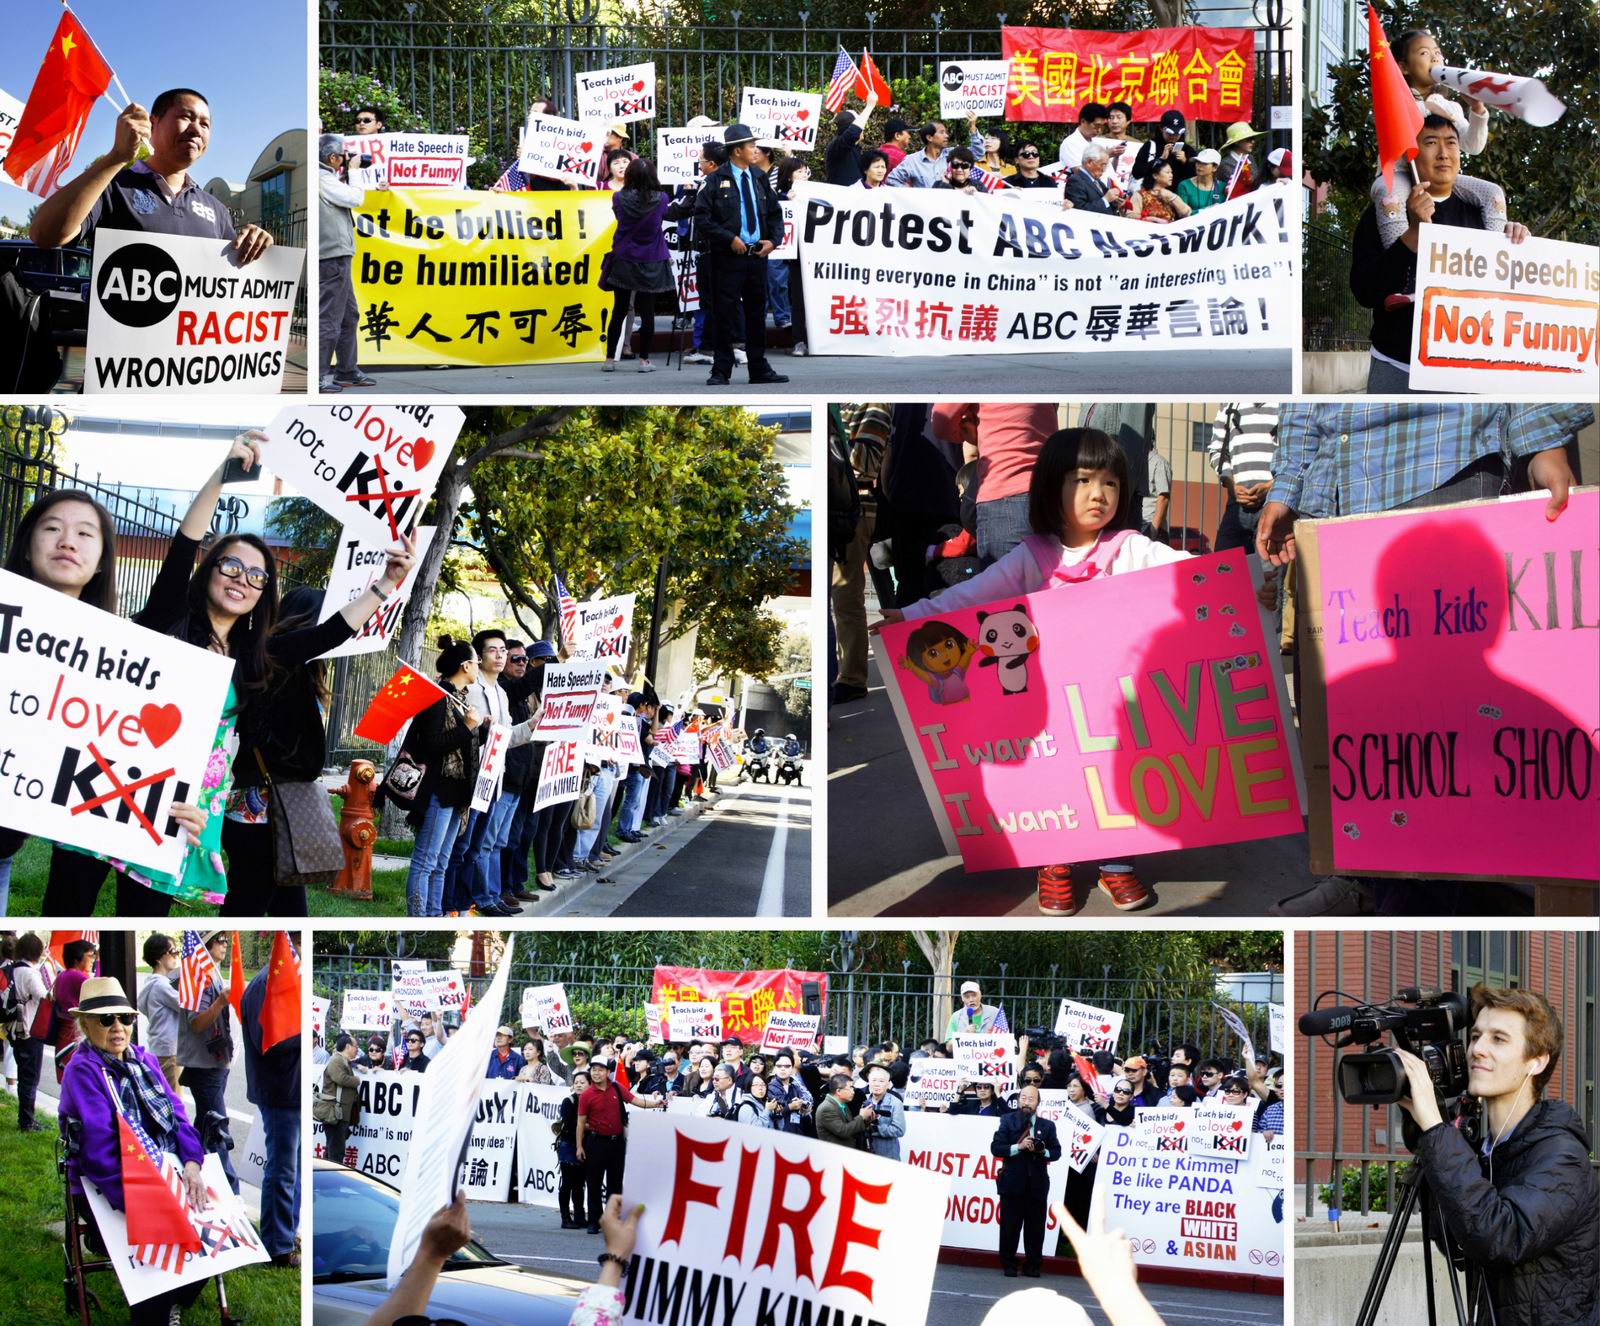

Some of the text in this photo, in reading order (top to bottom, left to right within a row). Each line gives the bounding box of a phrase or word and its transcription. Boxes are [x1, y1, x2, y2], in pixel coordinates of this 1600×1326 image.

[581, 73, 635, 91] Teach kids
[942, 69, 1006, 85] ABC MUST ADMIT
[1008, 48, 1247, 107] 美國北京聯合會
[594, 87, 635, 102] to love
[963, 84, 1005, 97] RACIST
[585, 95, 653, 120] not to Kill
[748, 94, 801, 108] Teach kids
[943, 98, 1004, 111] WRONGDOINGS
[768, 108, 798, 122] love
[534, 120, 586, 139] Teach kids
[774, 125, 814, 143] Kill
[390, 140, 464, 155] Hate Speech is
[540, 136, 582, 154] to love
[662, 134, 693, 146] Teach
[526, 152, 596, 177] not to Kill
[672, 151, 683, 159] to
[393, 163, 417, 178] Not
[420, 164, 459, 182] Funny
[663, 163, 681, 174] not
[785, 208, 793, 219] is
[404, 209, 444, 240] be
[456, 209, 562, 241] bullied
[803, 198, 974, 255] Protest
[993, 212, 1082, 260] ABC
[361, 253, 590, 286] be humiliated
[1429, 242, 1600, 291] Hate Speech is
[101, 268, 294, 303] ABC MUST ADMIT
[876, 269, 956, 288] everyone
[964, 272, 981, 290] in
[1054, 275, 1068, 291] is
[1075, 275, 1102, 291] not
[1145, 267, 1226, 289] interesting
[176, 311, 288, 345] RACIST
[829, 294, 999, 343] 強烈抗議
[1007, 311, 1078, 340] ABC
[1433, 305, 1595, 363] Not Funny
[95, 351, 282, 388] WRONGDOINGS
[353, 406, 414, 467] love
[286, 418, 325, 459] not
[313, 458, 337, 482] to
[1328, 550, 1600, 644] Teach kids KIL
[579, 609, 603, 626] Teach
[592, 622, 614, 639] love
[0, 604, 160, 690] Teach kids
[594, 636, 627, 660] Kill
[547, 669, 602, 691] Hate Speech is
[9, 674, 143, 747] to love
[545, 701, 563, 720] Not
[565, 698, 594, 722] Funny
[919, 651, 1278, 771] I want LIVE
[544, 741, 577, 780] FIRE
[1332, 731, 1471, 801] SCHOOL
[13, 772, 44, 799] to
[51, 746, 190, 838] Kill
[943, 737, 1292, 836] I want LOVE
[671, 1006, 690, 1015] Teach
[685, 1015, 706, 1024] love
[1064, 1005, 1106, 1023] Teach kids
[691, 1025, 720, 1037] Kill
[771, 1016, 817, 1029] Hate Speech is
[1076, 1018, 1101, 1035] love
[769, 1033, 812, 1048] Not Funny
[955, 1038, 997, 1048] Teach kids
[1080, 1034, 1114, 1053] Kill
[971, 1050, 996, 1061] love
[958, 1062, 1013, 1076] not Kill
[921, 1078, 957, 1090] RACIST
[358, 1081, 403, 1117] ABC
[1045, 1099, 1066, 1108] ADMIT
[1138, 1112, 1178, 1124] Teach kids
[1194, 1108, 1236, 1120] Teach kids
[385, 1127, 394, 1141] is
[1152, 1123, 1176, 1134] love
[1207, 1120, 1233, 1133] love
[1156, 1137, 1188, 1151] Kill
[1213, 1135, 1248, 1153] Kill
[362, 1153, 401, 1177] ABC
[908, 1150, 971, 1177] MUST
[1175, 1157, 1239, 1175] Kimmel
[1261, 1169, 1276, 1177] not
[524, 1168, 555, 1193] ABC
[1112, 1171, 1234, 1195] Be like PANDA
[1113, 1193, 1237, 1219] They are BLACK
[659, 1127, 894, 1306] FIRE
[1183, 1219, 1237, 1240] WHITE
[1166, 1240, 1237, 1262] & ASIAN
